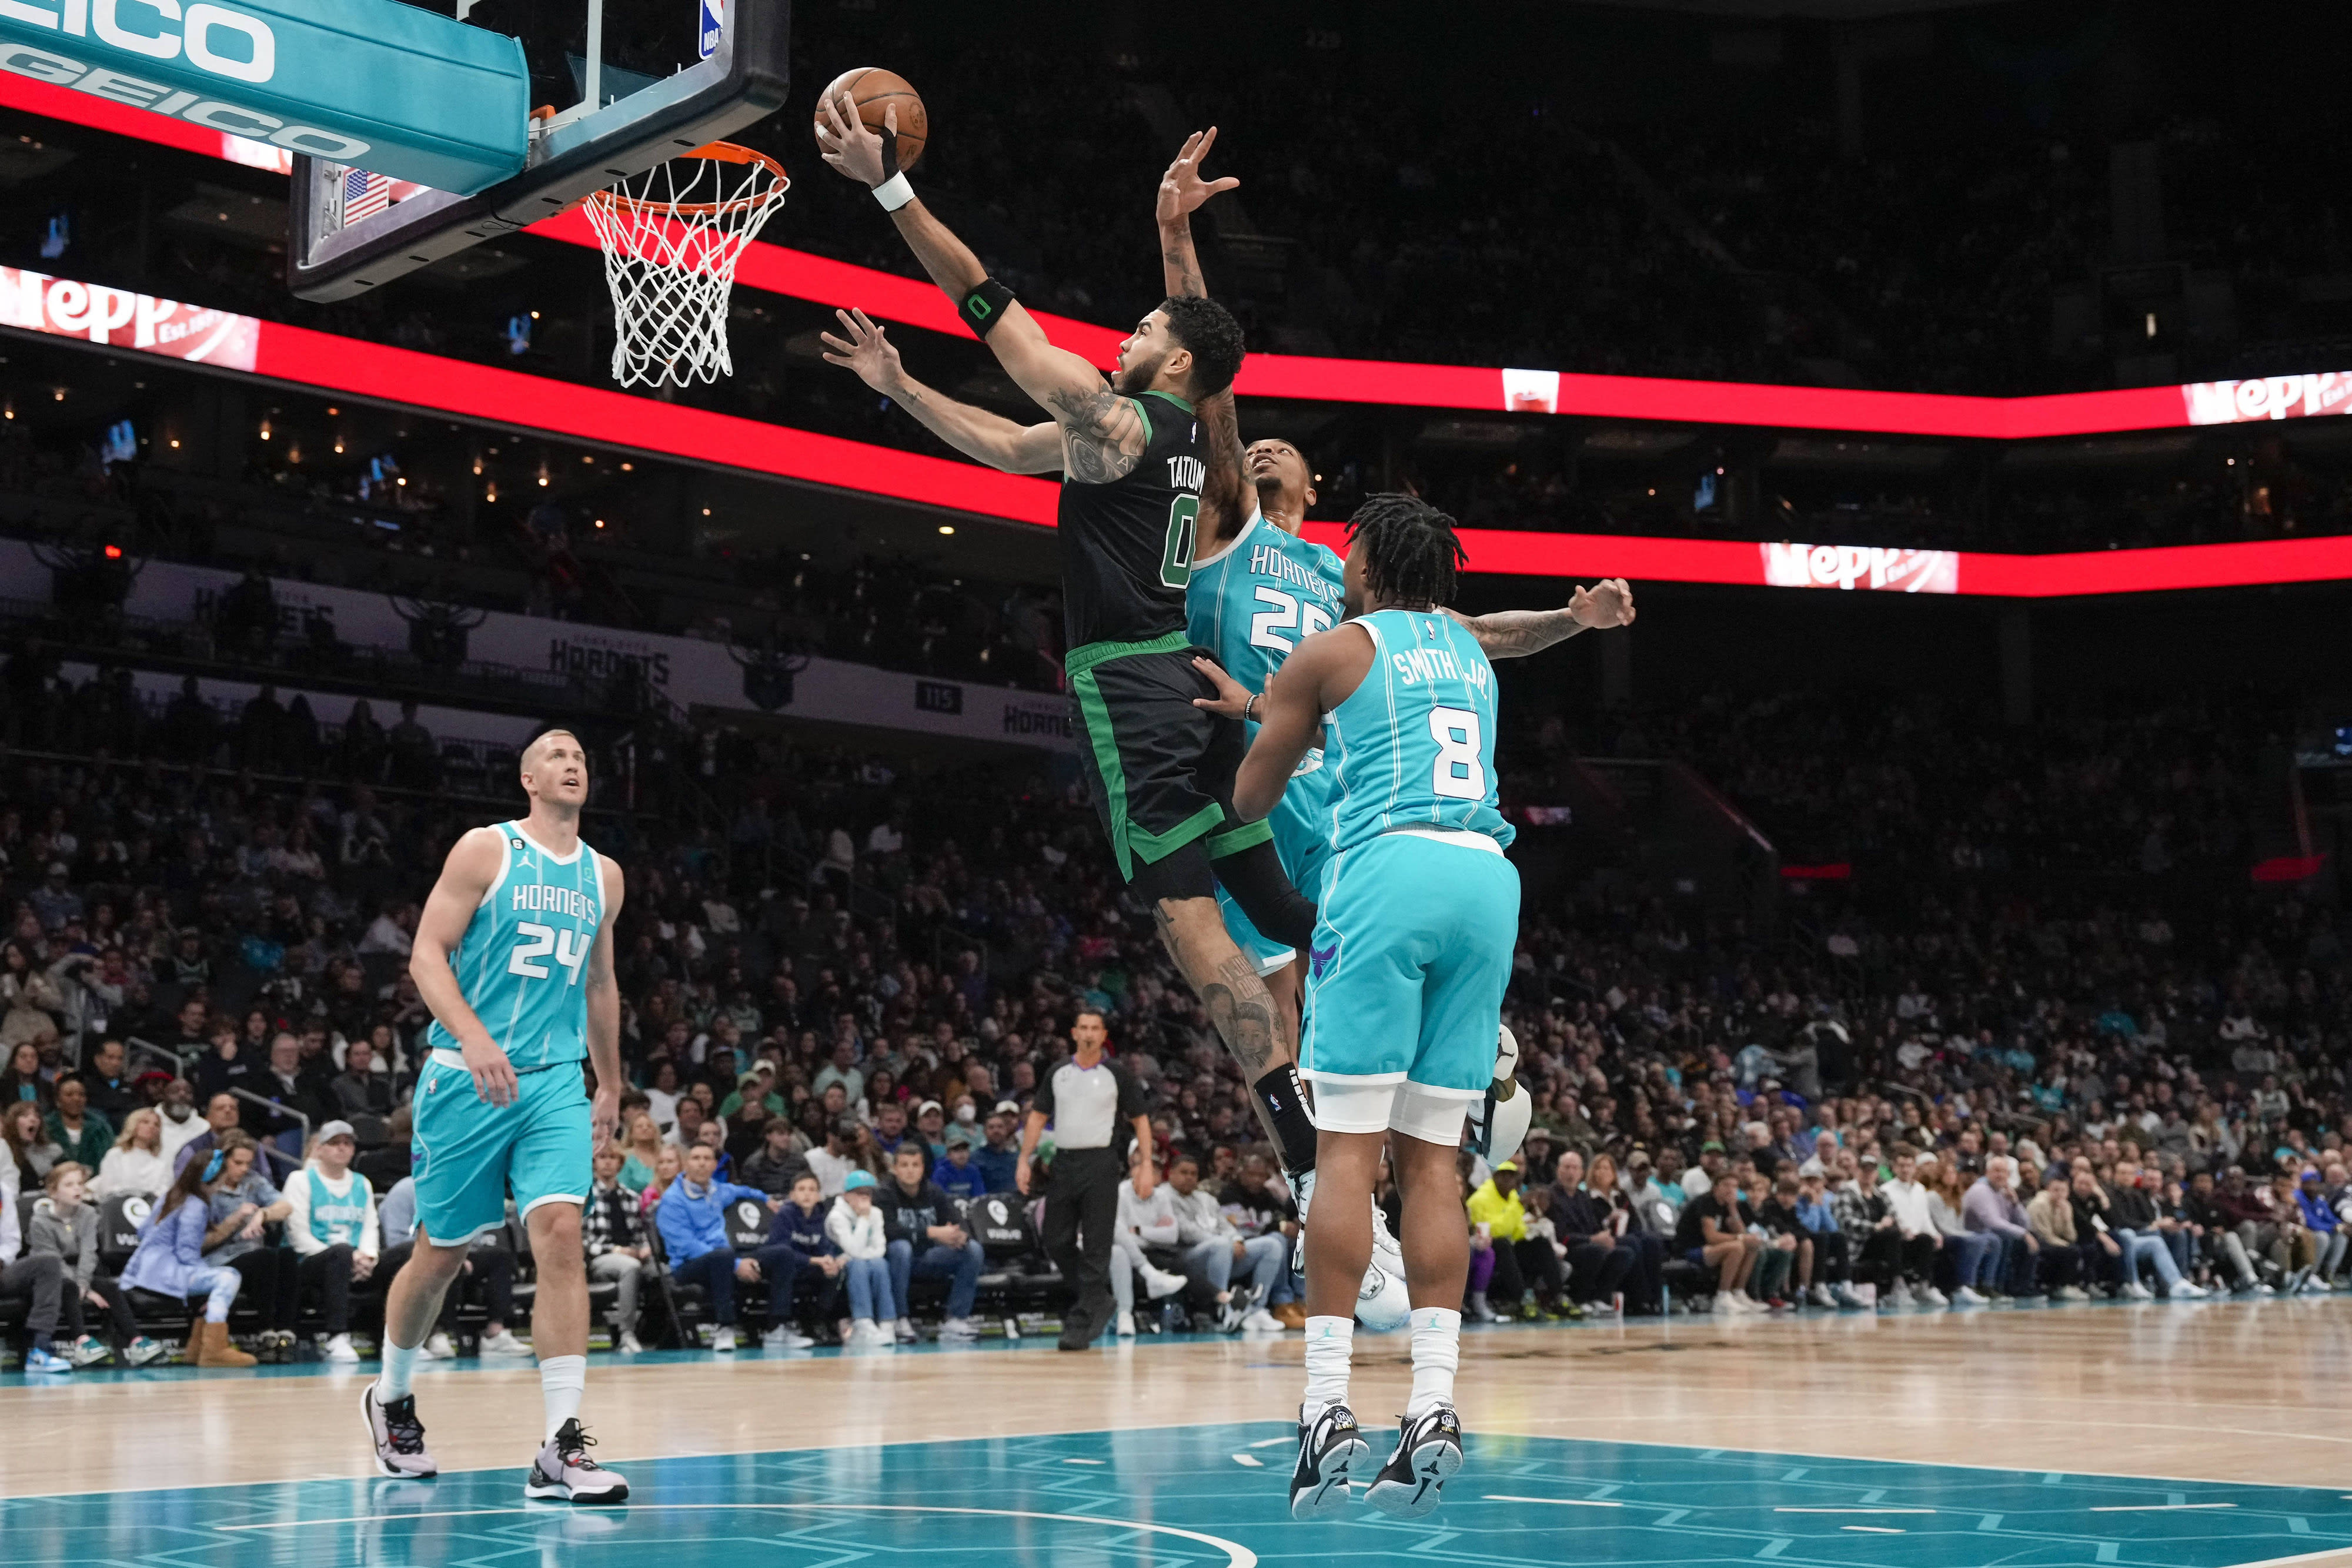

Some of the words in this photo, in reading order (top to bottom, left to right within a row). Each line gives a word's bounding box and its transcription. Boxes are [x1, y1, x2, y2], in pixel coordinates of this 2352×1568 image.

[704, 28, 719, 51] NBA
[0, 44, 371, 159] GEICO
[968, 295, 991, 319] 0
[1167, 456, 1206, 494] TATUM
[1160, 493, 1200, 589] 0
[1248, 544, 1341, 615] HORNETS
[1392, 648, 1458, 686] SMITH
[1465, 658, 1488, 701] JR.
[1428, 705, 1487, 801] 8
[512, 839, 523, 850] 6
[511, 884, 596, 927] HORNETS
[507, 921, 592, 987] 24
